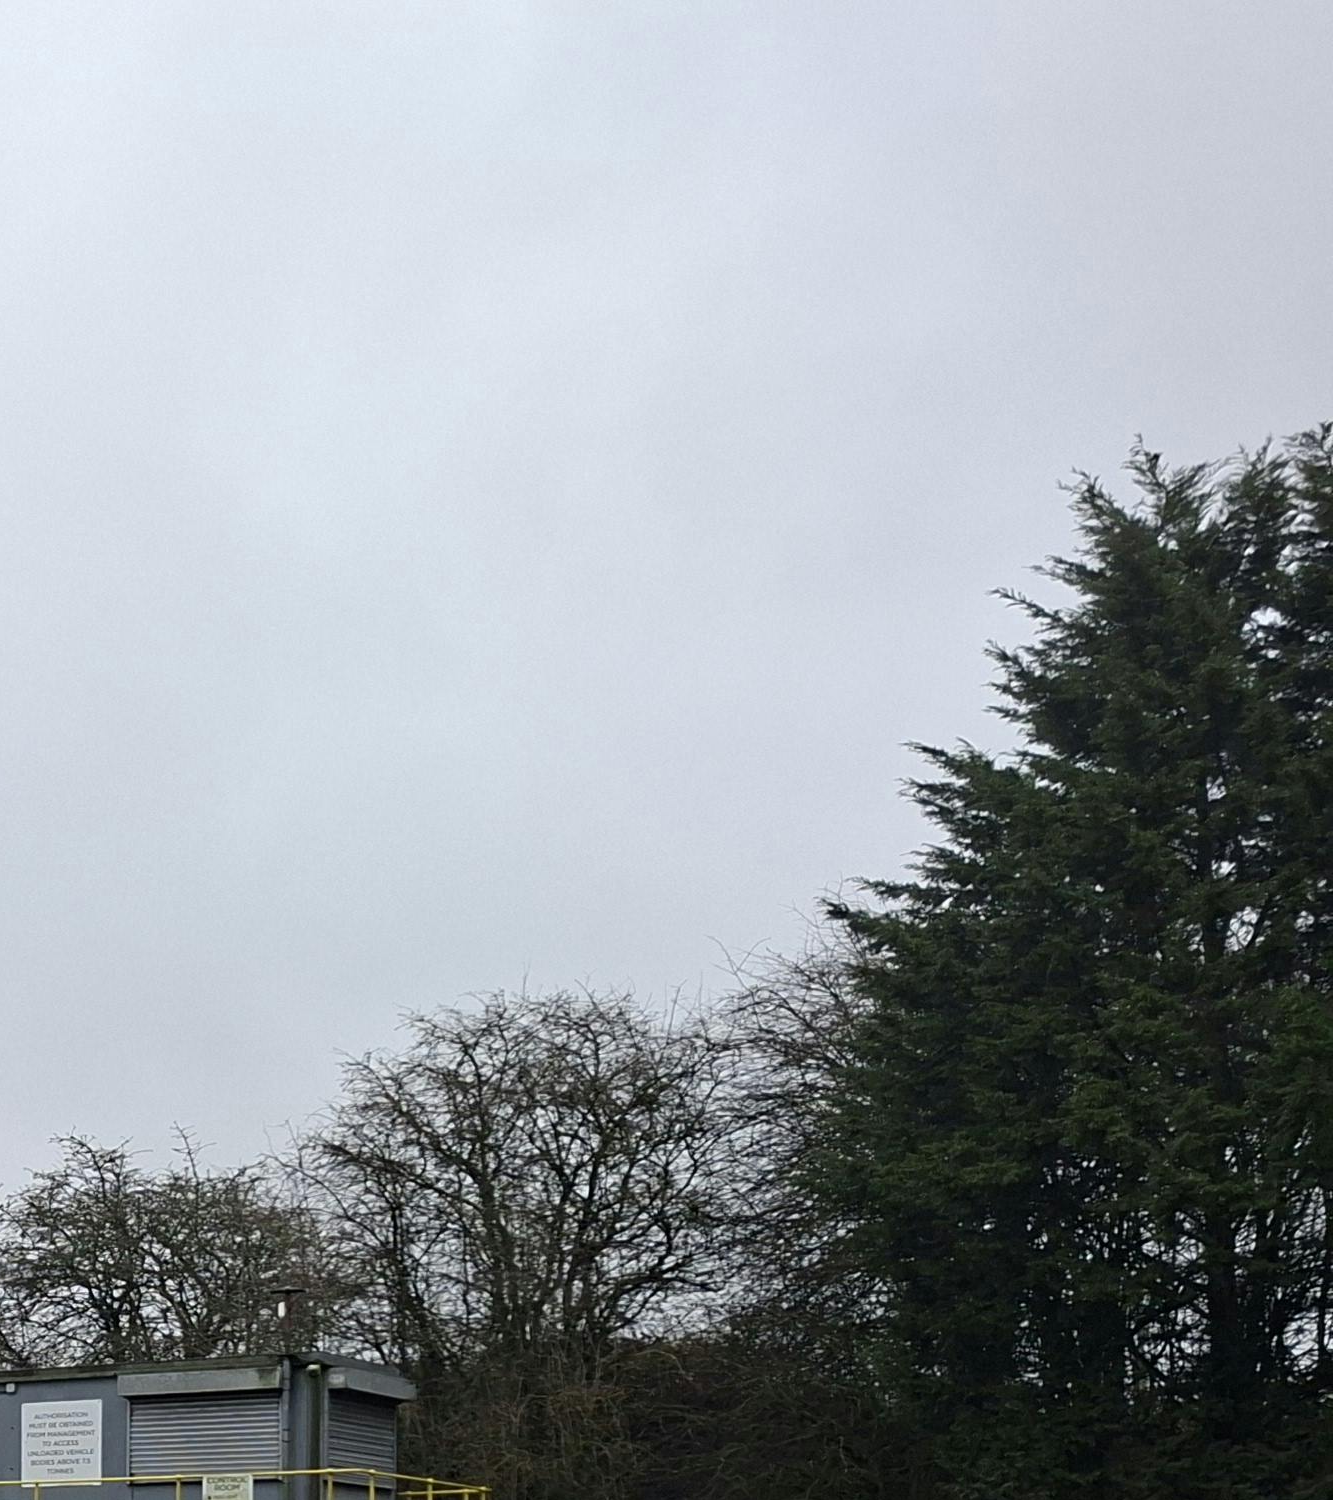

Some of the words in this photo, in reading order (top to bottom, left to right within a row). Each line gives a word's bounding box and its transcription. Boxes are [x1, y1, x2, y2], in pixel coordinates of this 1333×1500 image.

[34, 1411, 89, 1419] AUTHORISATION
[58, 1420, 94, 1428] OBTAINED
[206, 1476, 250, 1484] CONTROL
